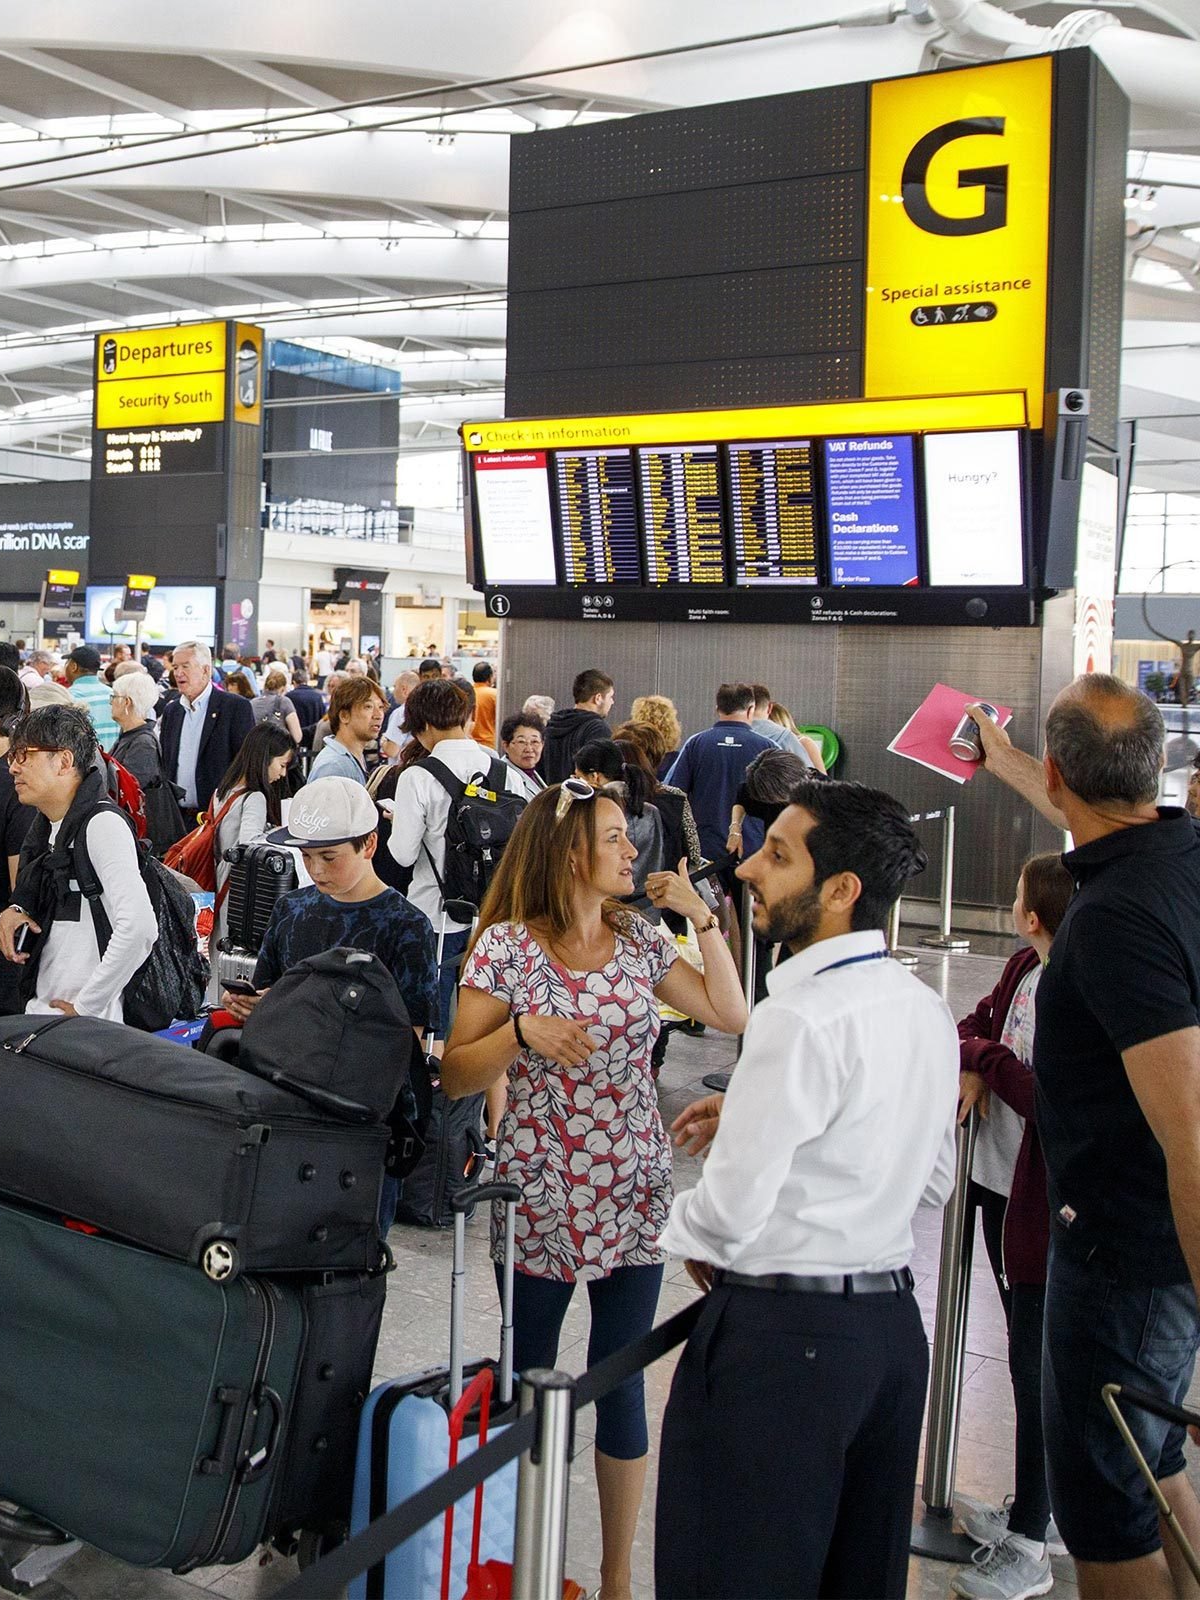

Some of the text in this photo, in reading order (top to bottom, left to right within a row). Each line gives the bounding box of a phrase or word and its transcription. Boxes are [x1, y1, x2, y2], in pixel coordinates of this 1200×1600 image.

[901, 116, 1009, 237] G
[881, 276, 1032, 303] Special assistance
[120, 340, 213, 364] Departures
[119, 390, 213, 409] Security South
[106, 428, 202, 446] How busy is Security?
[486, 426, 630, 443] Check-in information
[106, 448, 134, 461] North
[829, 440, 894, 452] VAT Refunds
[106, 461, 134, 474] South
[948, 472, 998, 484] Hungry?
[832, 512, 858, 522] Cash
[833, 524, 899, 534] Declarations
[31, 532, 61, 550] DNA
[293, 804, 330, 834] Ledge
